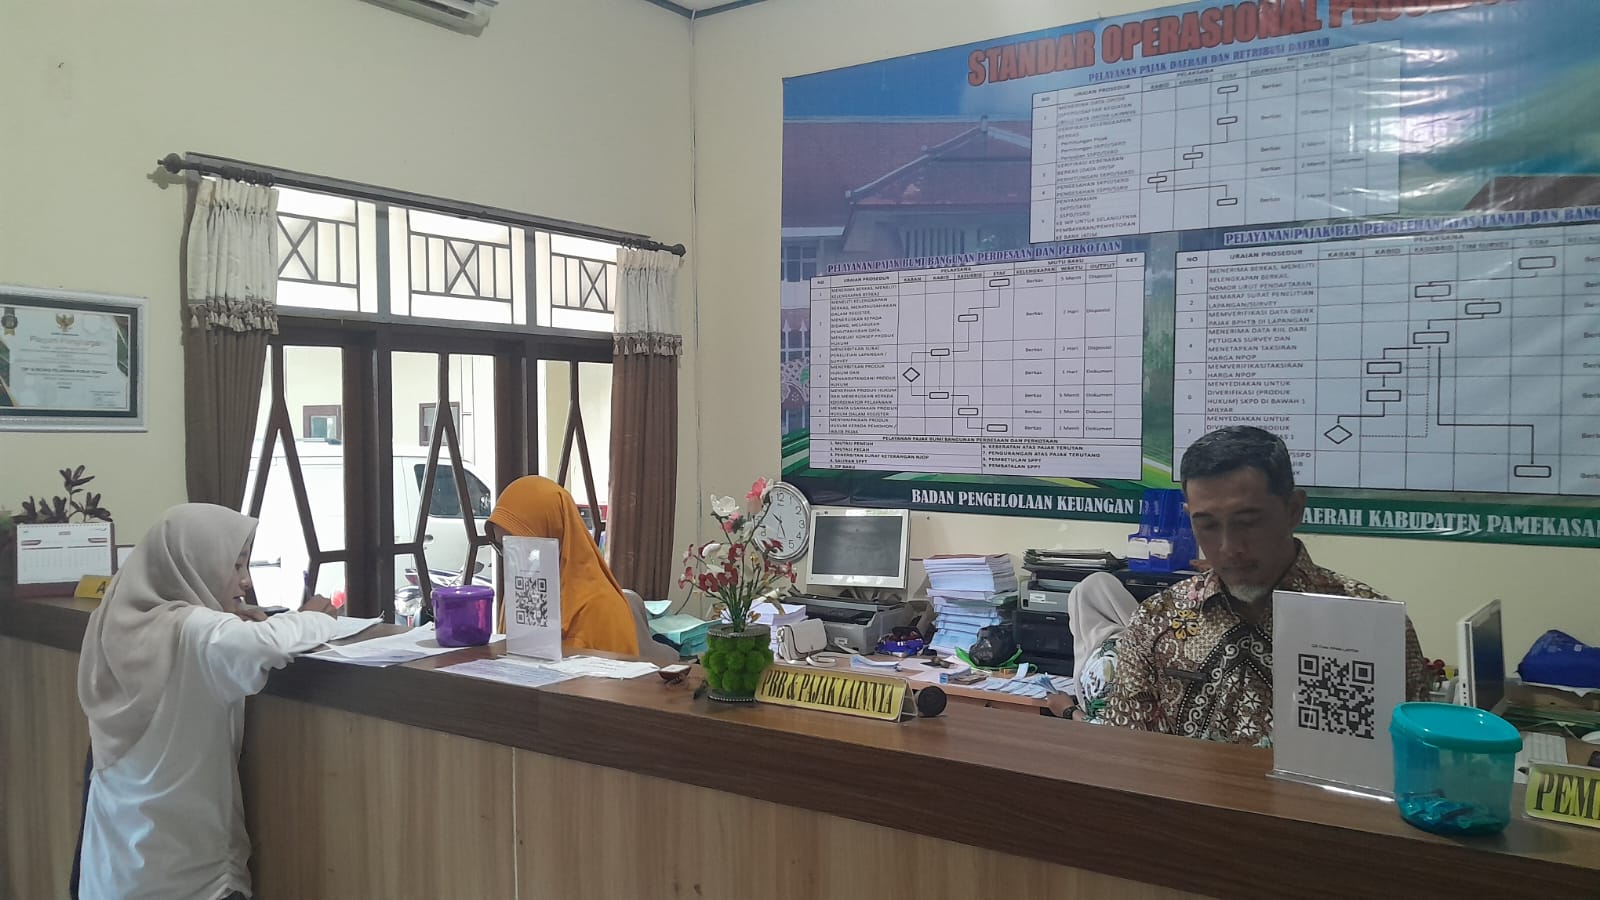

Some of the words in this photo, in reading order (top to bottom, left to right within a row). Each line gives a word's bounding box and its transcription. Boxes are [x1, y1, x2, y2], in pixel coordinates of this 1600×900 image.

[968, 30, 1095, 86] STANDAR
[1101, 0, 1322, 64] OPERASIONAL
[1088, 67, 1137, 82] PELAYANAN
[1139, 63, 1167, 75] PAJAK
[1170, 57, 1208, 70] DAERAH
[1211, 53, 1230, 65] DAN
[1289, 37, 1330, 52] DAERAH
[1225, 229, 1289, 245] PELAYANAN
[1293, 226, 1331, 240] PAJAK
[1335, 224, 1360, 237] BEA
[1482, 212, 1525, 226] TANAH
[1530, 209, 1559, 223] DAN
[828, 260, 872, 273] PELAYANAN
[875, 257, 900, 270] PAJAK
[902, 255, 925, 267] BUMI
[928, 252, 974, 266] BANGUNAN
[977, 248, 1032, 262] PERDESAAN
[1035, 246, 1056, 257] DAN
[1058, 241, 1121, 255] PERKOTAAN
[1229, 253, 1259, 261] URAIAN
[1261, 250, 1303, 258] PROSEDUR
[1208, 336, 1242, 344] PETUGAS
[1208, 345, 1259, 353] MENETAPKAN
[1207, 398, 1238, 406] HUKUM)
[795, 505, 801, 515] 2
[911, 488, 954, 505] BADAN
[958, 491, 1053, 510] PENGELOLAAN
[1057, 496, 1134, 514] KEUANGAN
[1302, 507, 1363, 527] AERAH
[1369, 510, 1481, 532] KABUPATEN
[798, 519, 805, 528] 3
[788, 539, 795, 549] 5
[761, 669, 788, 699] PBB
[786, 672, 799, 700] &
[798, 673, 841, 707] PAJAK
[837, 678, 895, 714] LAINNYA
